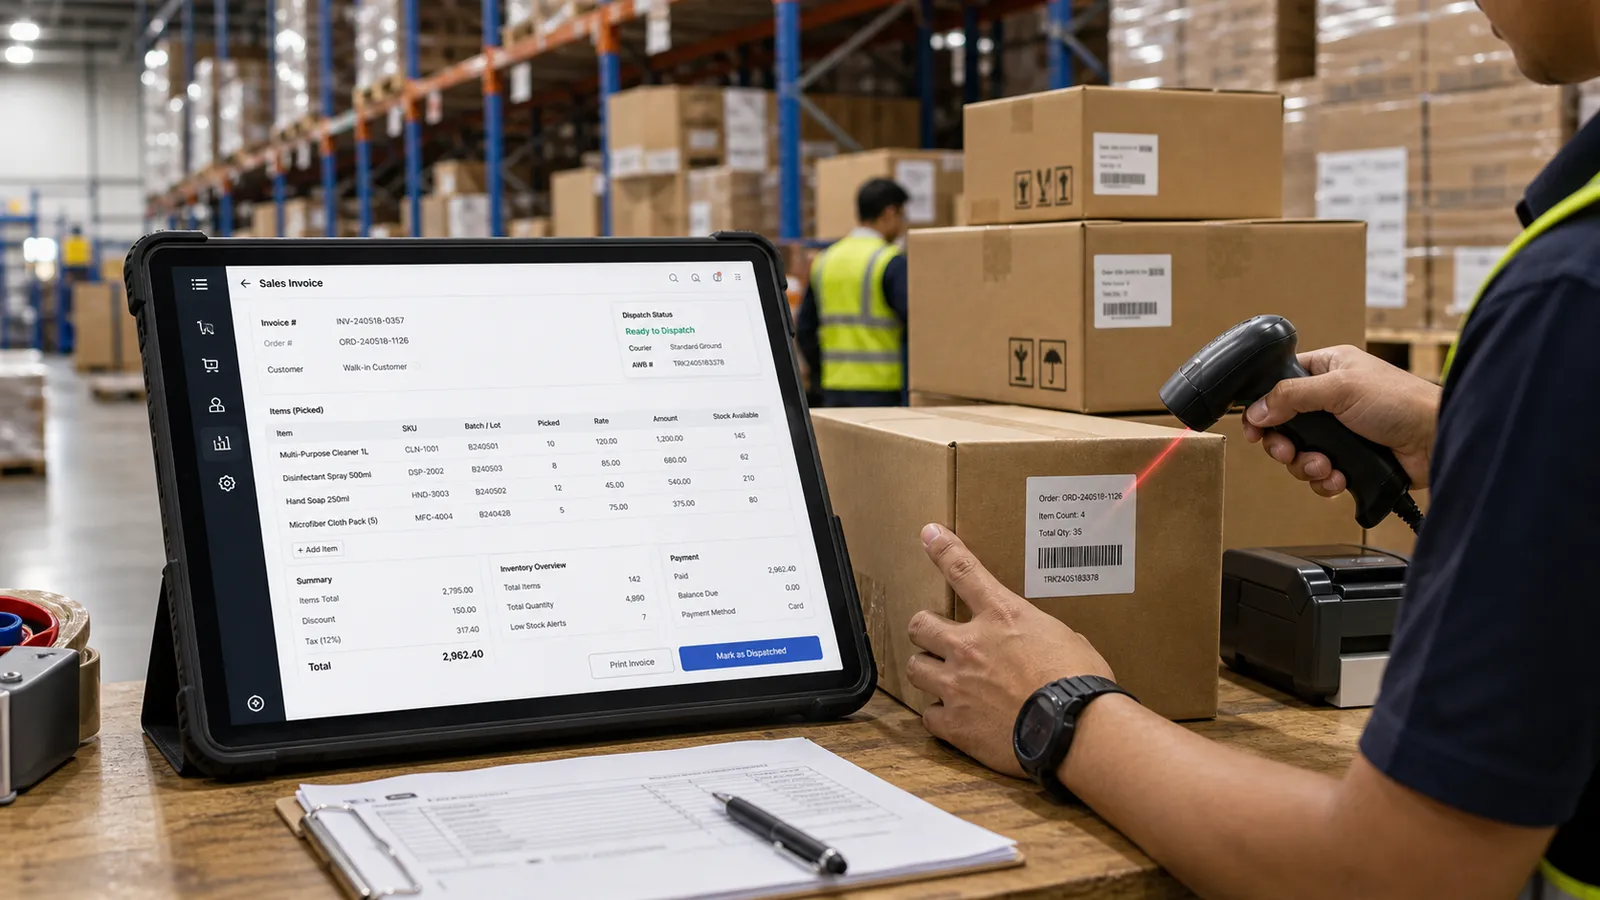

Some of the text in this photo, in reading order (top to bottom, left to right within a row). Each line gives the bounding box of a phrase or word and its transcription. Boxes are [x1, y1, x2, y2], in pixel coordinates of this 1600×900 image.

[259, 278, 323, 288] Sales Invoice
[622, 311, 651, 319] Dispatch
[261, 319, 289, 327] Invoice
[625, 328, 649, 336] Ready
[661, 326, 695, 335] Dispatch
[264, 339, 285, 347] Order
[267, 365, 303, 373] Customer
[343, 363, 407, 371] Walk-in Customer
[270, 406, 324, 415] Items (Picked)
[713, 412, 731, 420] Stock
[656, 435, 683, 443] 1,200.00
[405, 445, 439, 453] CLN-1001
[280, 450, 331, 459] Multi-Purpose
[332, 449, 359, 457] Cleaner
[740, 453, 749, 461] 62
[663, 456, 687, 464] 680.00
[408, 467, 444, 476] DSP-2002
[471, 465, 503, 473] B240503
[283, 471, 372, 482] Disinfectant Spray 500ml
[605, 481, 625, 489] 45.00
[412, 490, 449, 498] HND-3003
[475, 487, 507, 495] B240502
[286, 495, 350, 505] Hand Soap 250ml
[673, 499, 695, 507] 375.00
[609, 503, 628, 511] 75.00
[415, 513, 453, 522] MFC-4004
[479, 510, 511, 518] B240428
[1055, 511, 1078, 519] Count:
[289, 520, 326, 529] Microfiber
[327, 518, 347, 526] Cloth
[368, 517, 378, 525] (5)
[1039, 529, 1055, 537] Total
[1057, 529, 1071, 537] Qty:
[670, 554, 699, 562] Payment
[500, 561, 566, 573] Inventory Overview
[767, 564, 796, 574] 2,962.40
[628, 575, 641, 583] 142
[674, 572, 689, 580] Paid
[296, 576, 332, 585] Summary
[442, 586, 474, 596] 2,795.00
[504, 583, 521, 591] Total
[785, 583, 800, 591] 0.00
[678, 591, 704, 599] Balance
[299, 595, 339, 605] Items Total
[452, 606, 477, 614] 150.00
[507, 601, 554, 611] Total Quantity
[788, 602, 804, 611] Card
[681, 607, 736, 619] Payment Method
[302, 615, 336, 625] Discount
[510, 620, 567, 631] Low Stock Alerts
[456, 626, 480, 634] 317.40
[305, 636, 341, 645] Tax (12%)
[443, 649, 484, 662] 2,962.40
[716, 651, 735, 660] Mark
[746, 647, 787, 658] Dispatched
[308, 662, 331, 671] Total
[610, 658, 655, 668] Print Invoice
